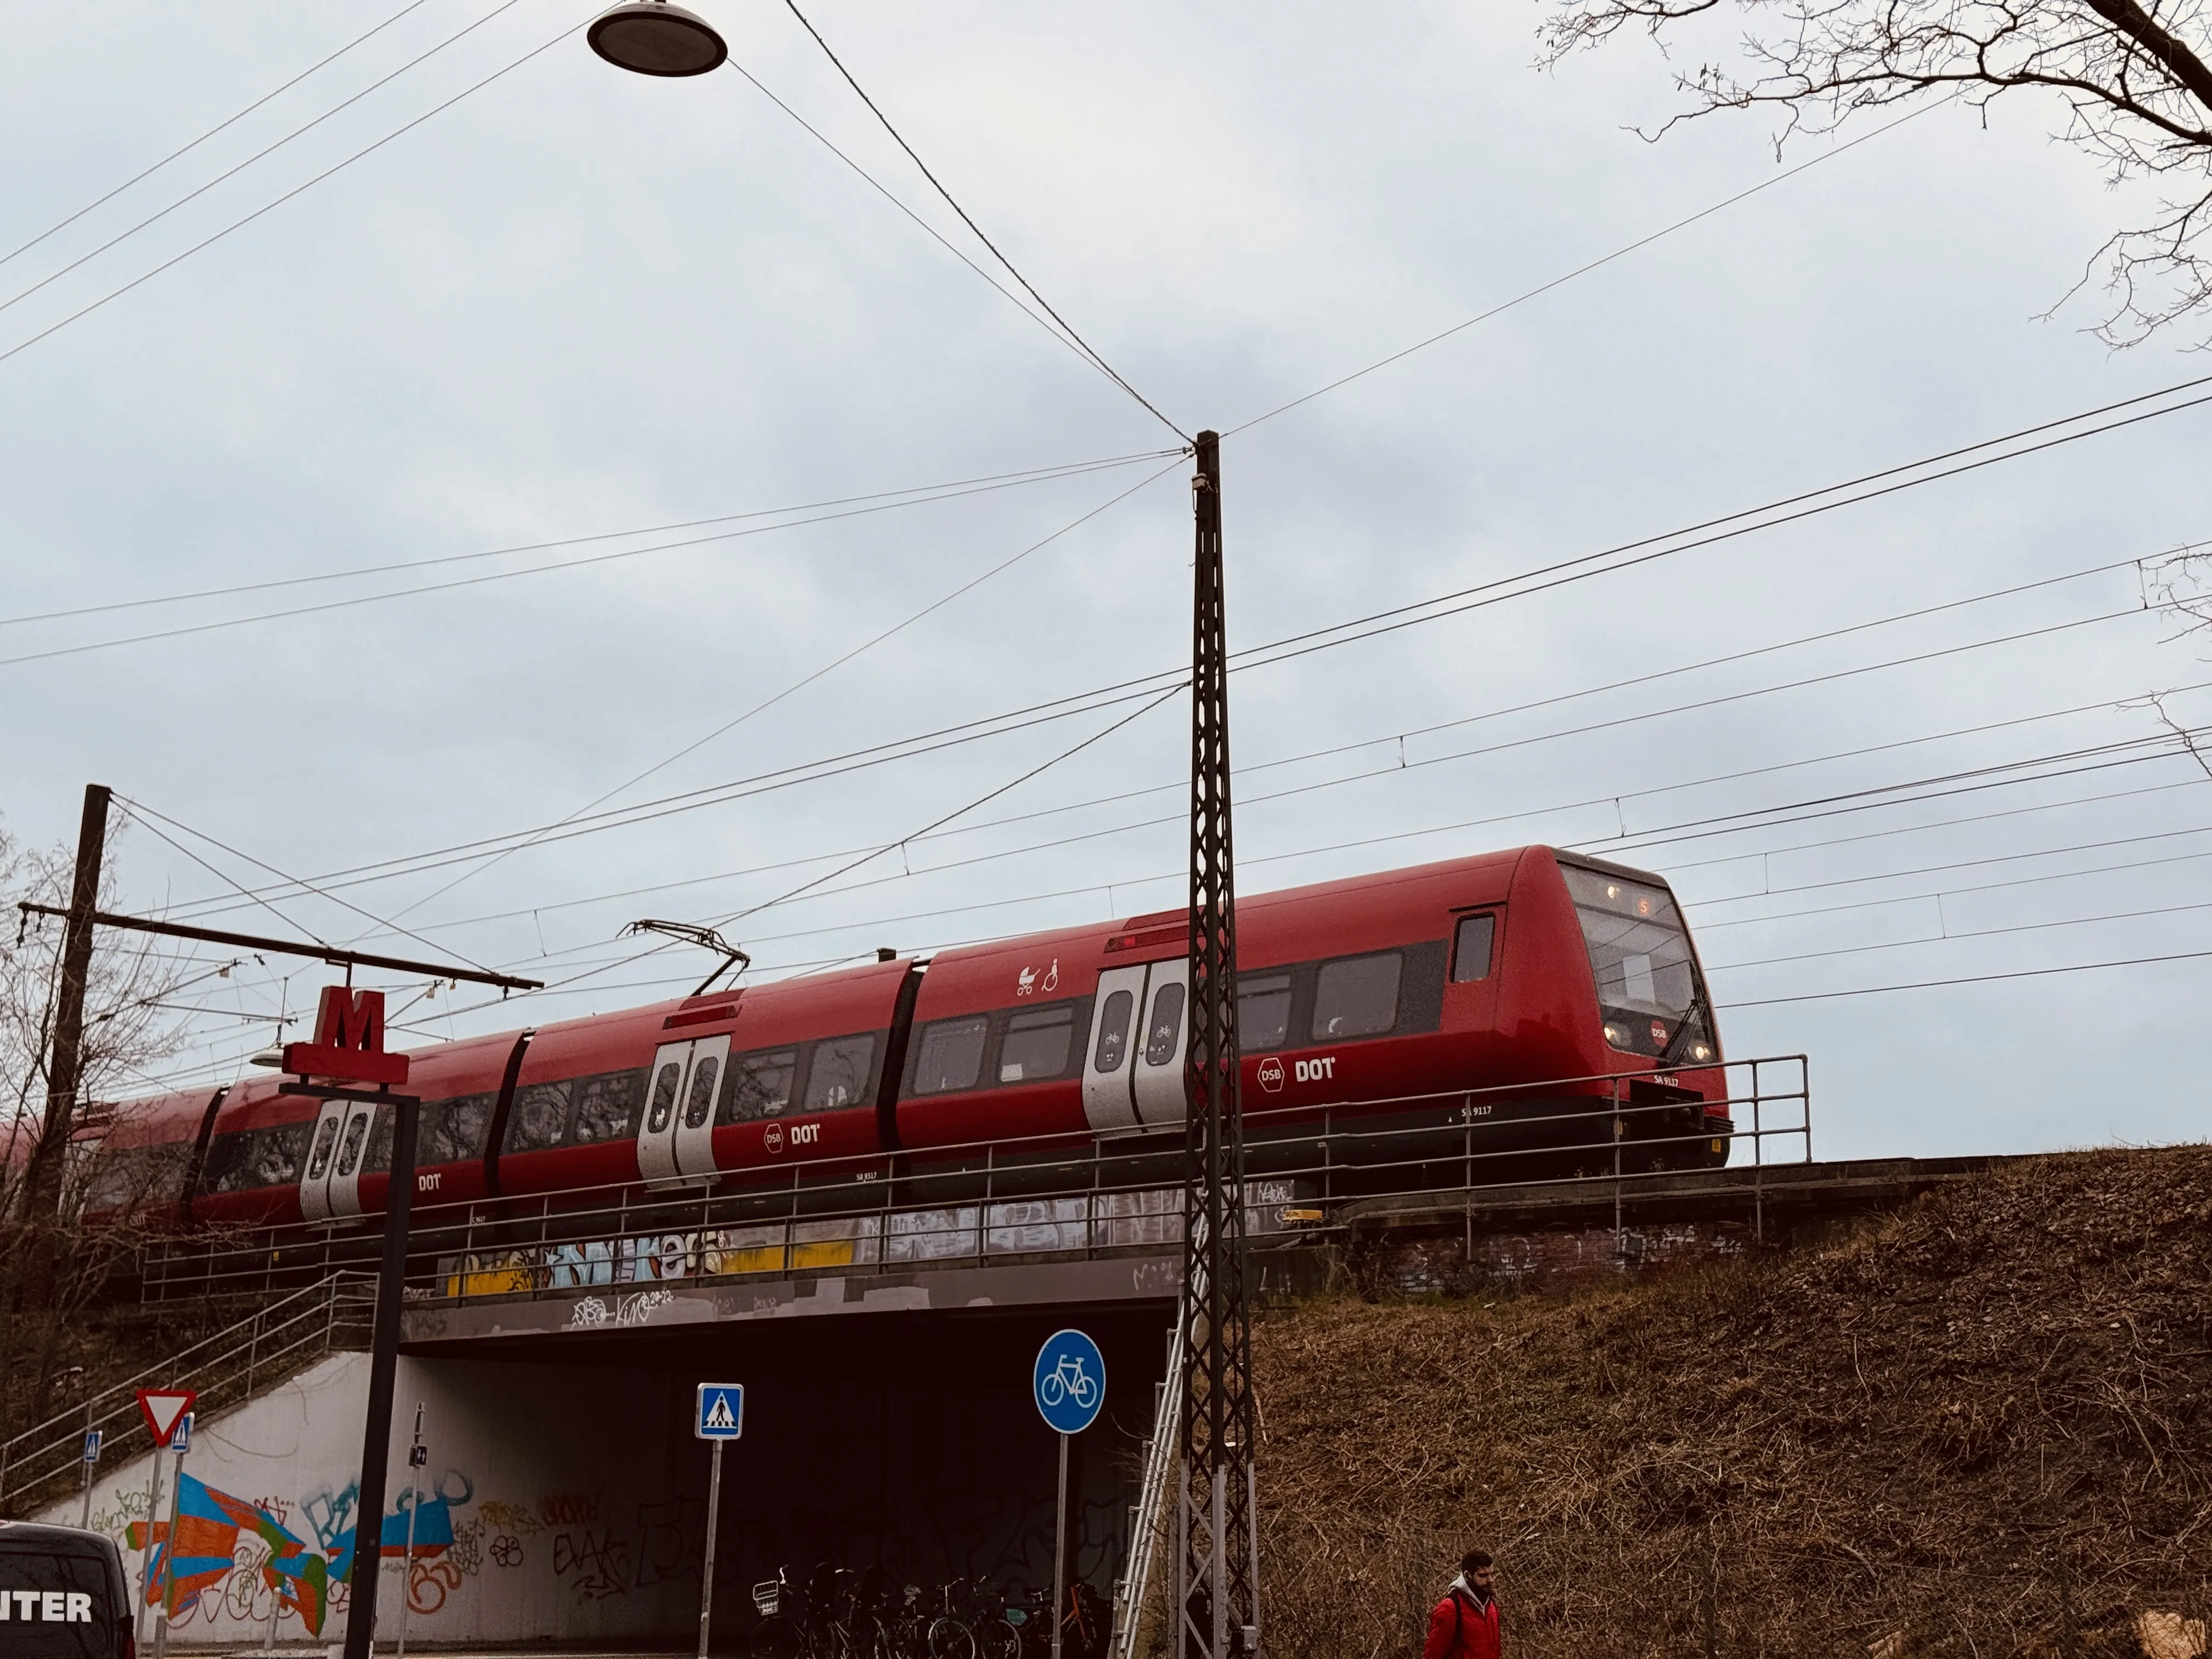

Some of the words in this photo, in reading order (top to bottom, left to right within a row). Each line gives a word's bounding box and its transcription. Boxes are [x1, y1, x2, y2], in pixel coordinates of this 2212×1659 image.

[313, 986, 385, 1053] M
[1652, 1028, 1666, 1039] DSB
[1262, 1069, 1281, 1081] DSB
[1295, 1057, 1336, 1082] DOT
[1654, 1075, 1664, 1085] SA
[1664, 1077, 1679, 1087] 9117
[1473, 1105, 1492, 1116] 9117
[767, 1133, 781, 1144] DSB
[791, 1124, 820, 1145] DOT
[419, 1173, 441, 1191] DOT
